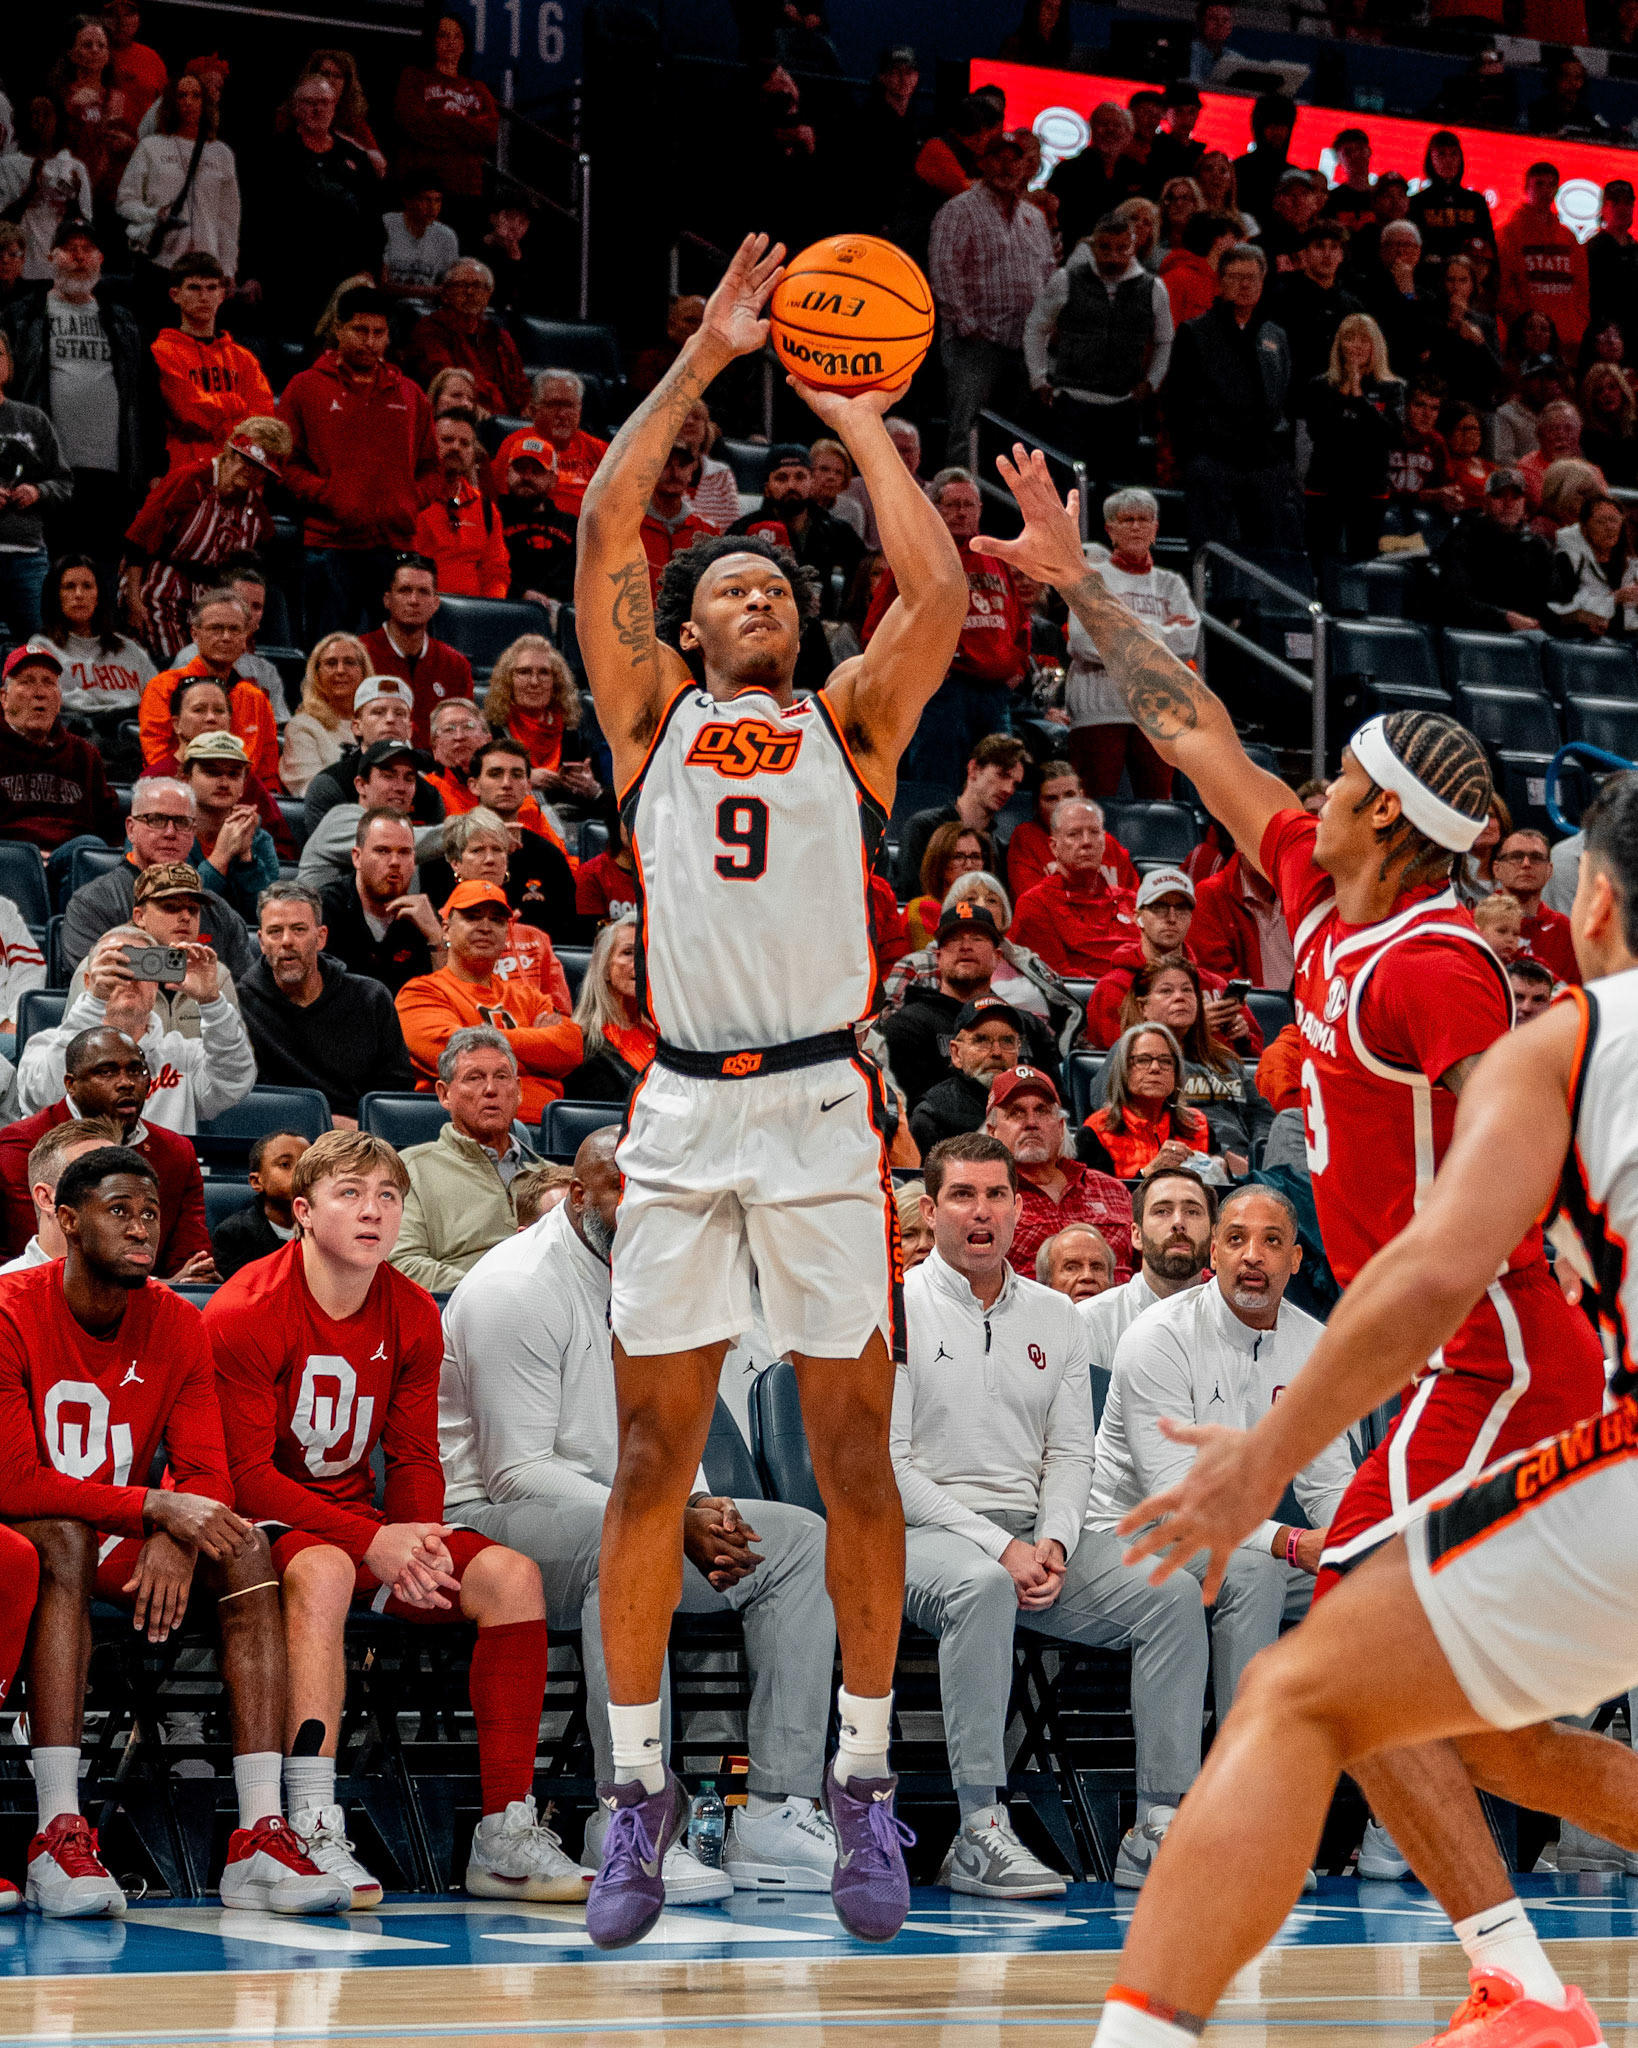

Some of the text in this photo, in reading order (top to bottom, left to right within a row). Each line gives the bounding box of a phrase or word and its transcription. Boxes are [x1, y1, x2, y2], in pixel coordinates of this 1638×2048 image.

[468, 0, 565, 64] 116
[57, 338, 112, 362] STATE
[782, 333, 885, 377] Wilson
[684, 717, 804, 781] OSU
[714, 796, 770, 882] 9
[608, 899, 638, 919] BO
[721, 1051, 763, 1077] OSU
[1301, 1058, 1330, 1176] 3
[1027, 1343, 1047, 1370] OU
[290, 1354, 375, 1478] OU
